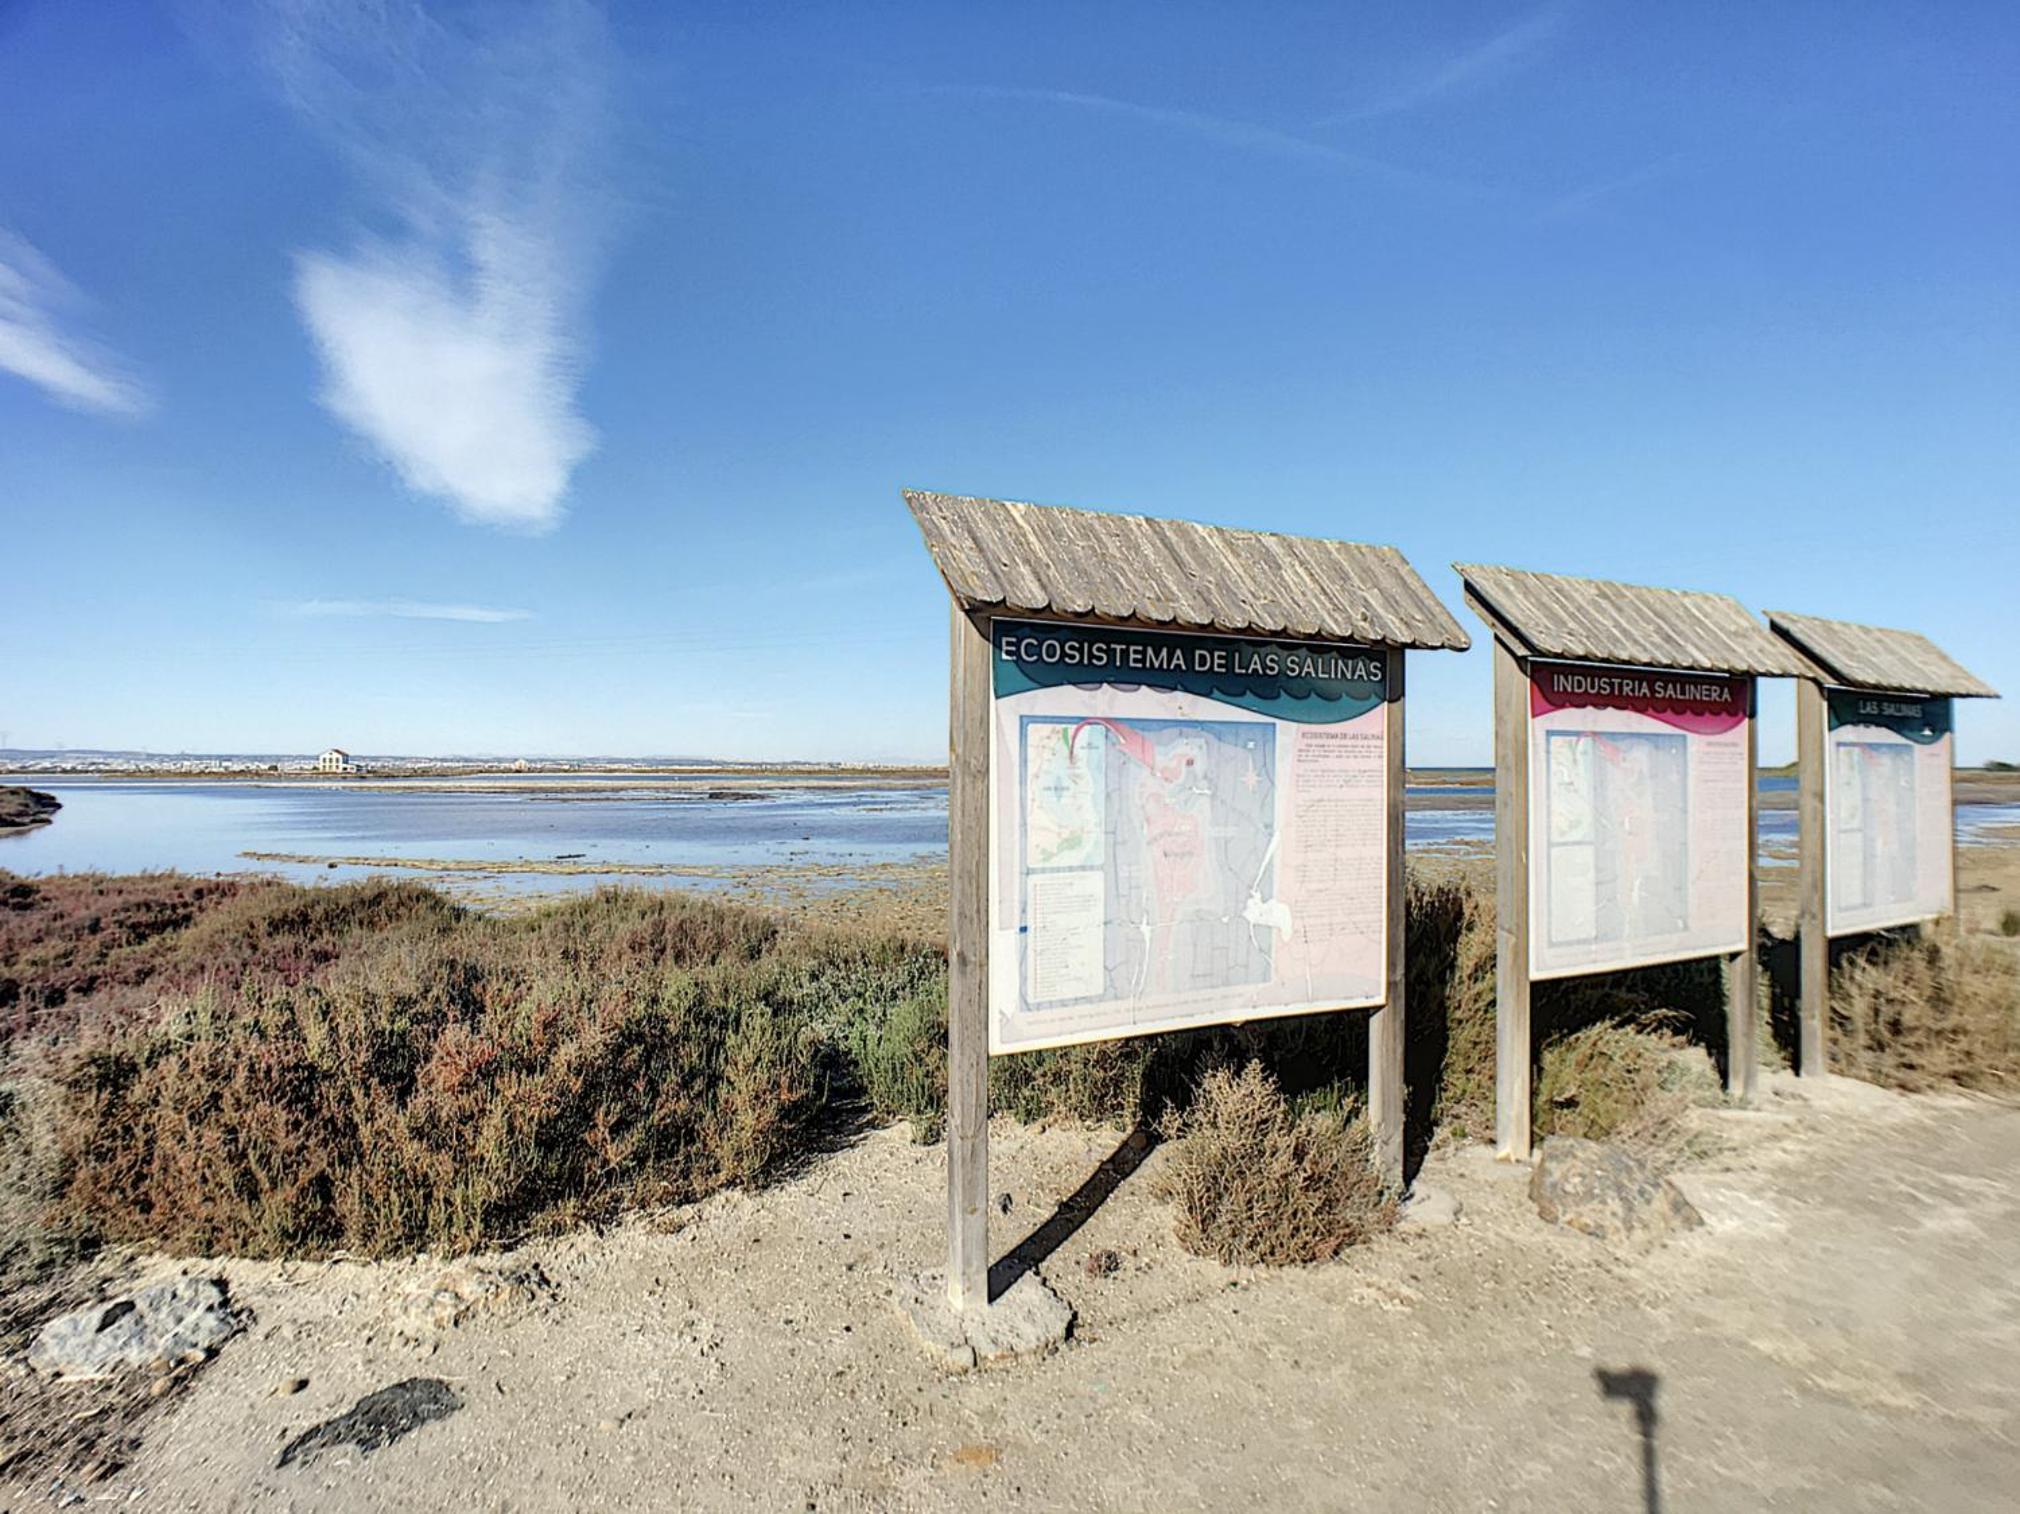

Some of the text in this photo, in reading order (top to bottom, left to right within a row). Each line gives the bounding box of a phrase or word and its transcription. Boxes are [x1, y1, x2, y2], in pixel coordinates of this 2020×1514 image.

[1001, 637, 1382, 681] ECOSISTEMA DE LAS SALINAS
[1553, 674, 1732, 702] INDUSTRIA SALINERA
[1859, 700, 1880, 714] LAS
